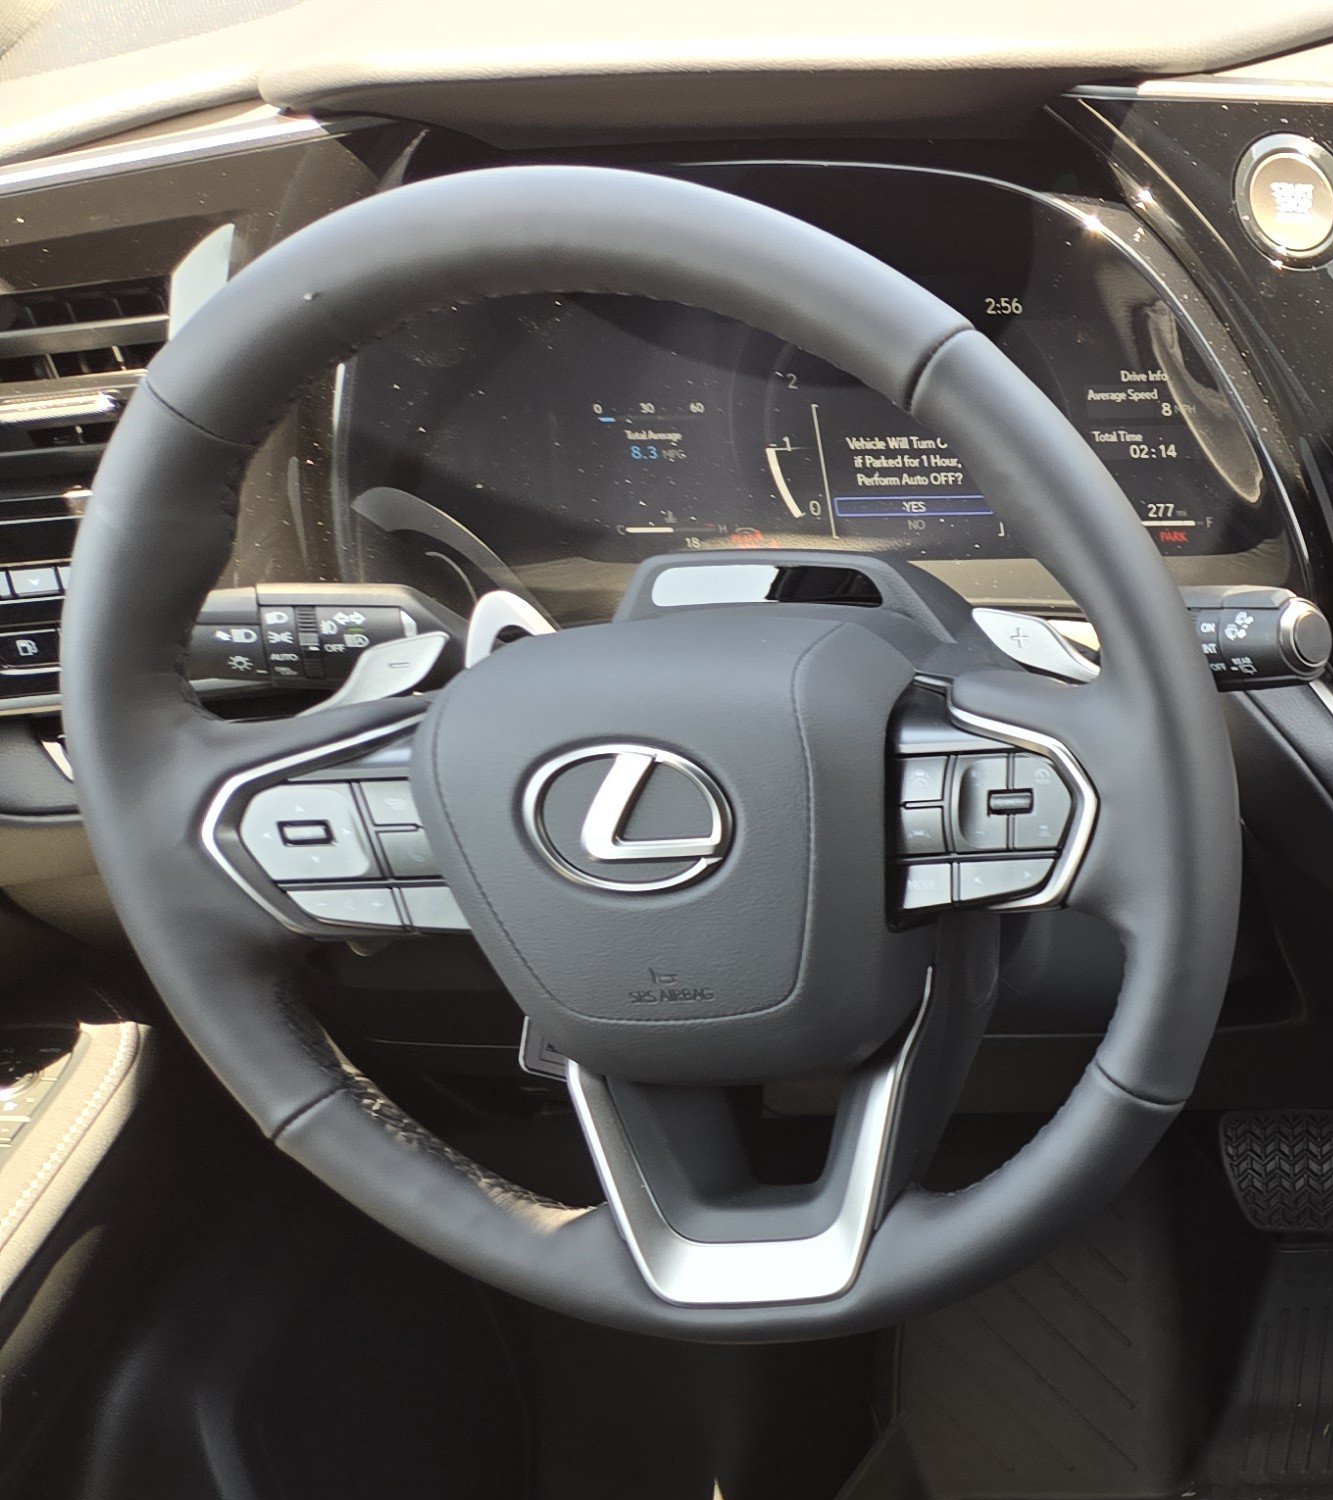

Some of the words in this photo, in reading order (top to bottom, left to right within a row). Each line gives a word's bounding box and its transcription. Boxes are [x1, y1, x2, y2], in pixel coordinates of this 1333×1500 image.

[984, 297, 1023, 315] 2:56
[786, 373, 799, 390] 2
[1120, 370, 1147, 382] Drive
[1148, 370, 1168, 382] Info
[1087, 389, 1127, 403] Average
[1127, 388, 1158, 402] Speed
[593, 403, 602, 414] 0
[639, 402, 655, 414] 30
[690, 402, 705, 414] 60
[1161, 402, 1173, 417] 8
[1092, 431, 1118, 442] Total
[1118, 431, 1143, 442] Time
[782, 436, 792, 452] 1
[845, 437, 886, 450] Vehicle
[887, 437, 909, 450] Will
[910, 437, 936, 449] Turn
[630, 446, 658, 460] 8.3
[1129, 444, 1178, 459] 02:14
[854, 456, 863, 468] if
[865, 456, 902, 468] Parked
[903, 455, 920, 467] for
[930, 455, 963, 468] Hour,
[856, 471, 900, 486] Perform
[901, 473, 929, 486] Auto
[930, 473, 963, 485] OFF?
[809, 500, 821, 517] 0
[904, 501, 926, 513] YES
[1147, 503, 1175, 518] 277
[907, 519, 926, 531] NO
[1205, 517, 1214, 528] F
[1159, 531, 1189, 542] PARK
[1200, 622, 1216, 633] ON
[324, 643, 346, 653] OFF
[270, 653, 299, 662] AUTO
